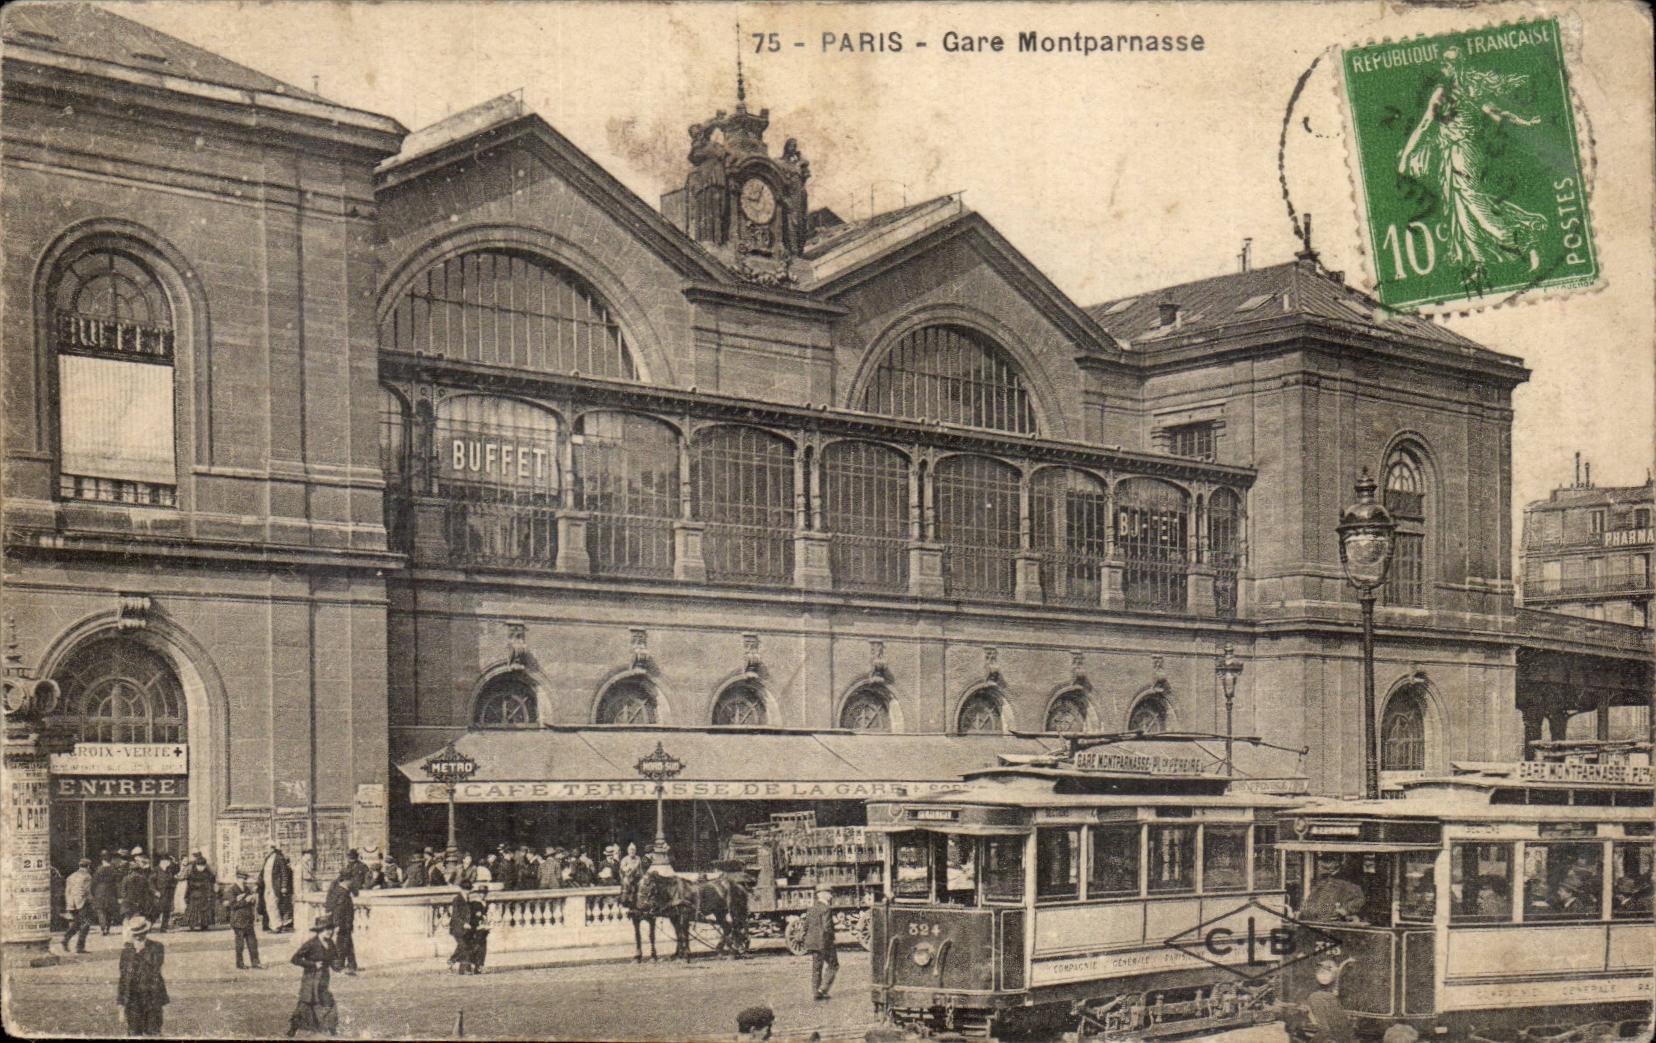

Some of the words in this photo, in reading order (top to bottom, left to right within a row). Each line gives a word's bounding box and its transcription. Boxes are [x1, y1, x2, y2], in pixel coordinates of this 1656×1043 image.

[1554, 176, 1587, 266] POSTES
[453, 440, 547, 478] BUFFET
[431, 762, 473, 773] METRO
[1077, 753, 1096, 768] GARE
[1520, 762, 1546, 779] GARE
[59, 780, 175, 796] ENTREE
[743, 783, 780, 796] DE
[791, 783, 821, 796] LA
[908, 922, 941, 937] 324
